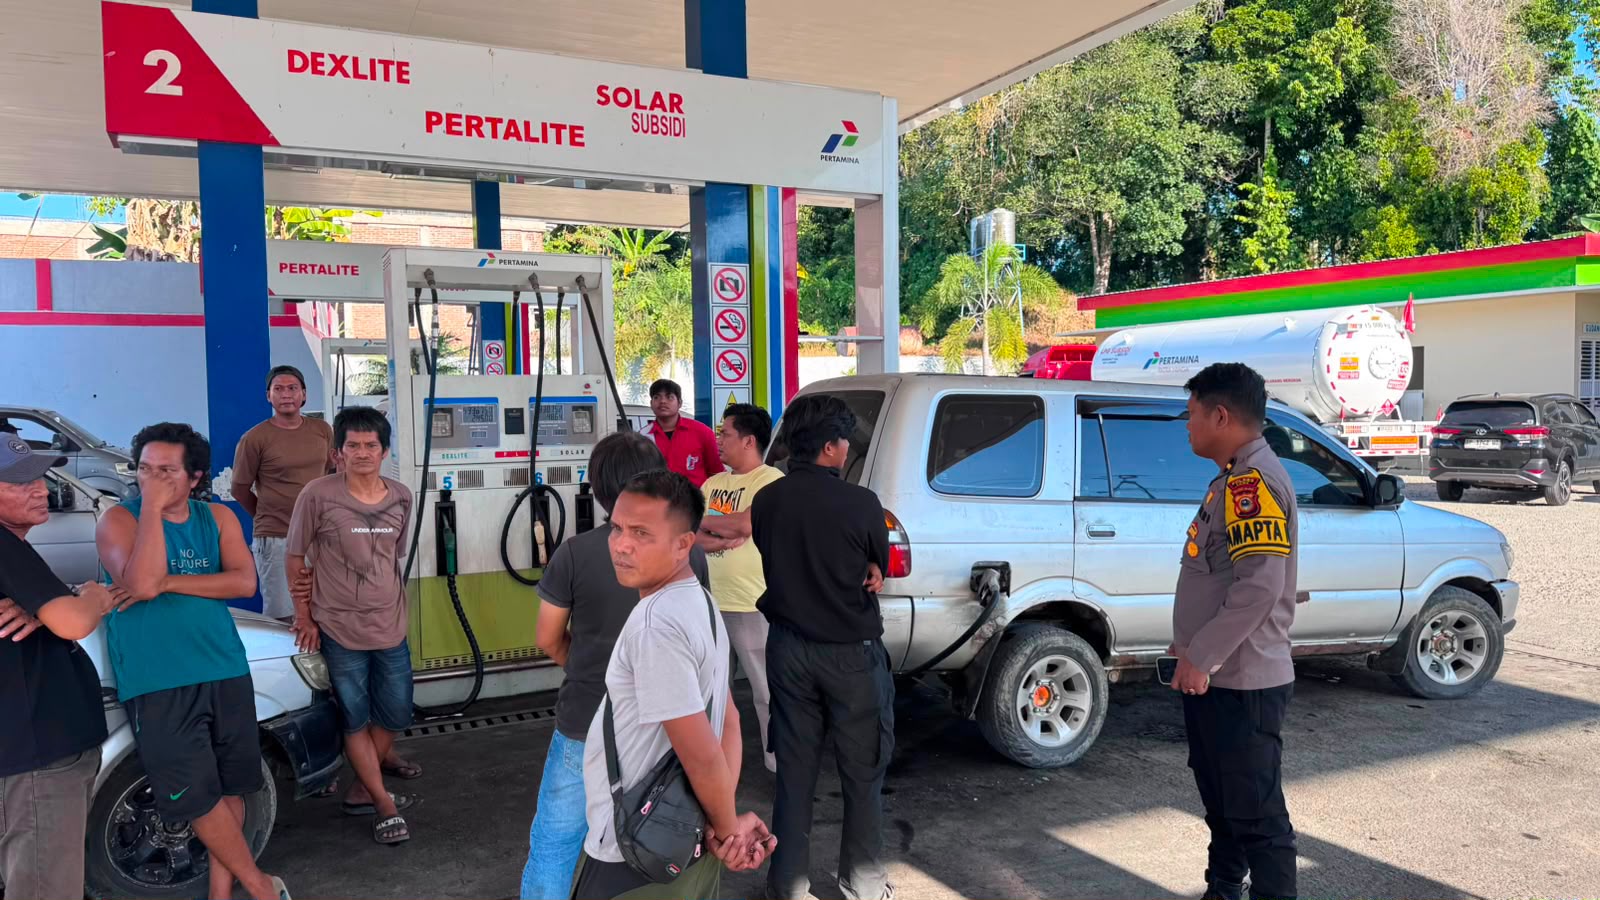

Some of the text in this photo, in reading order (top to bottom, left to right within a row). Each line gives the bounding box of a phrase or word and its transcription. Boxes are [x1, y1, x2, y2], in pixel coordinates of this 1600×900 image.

[142, 49, 184, 97] 2
[286, 49, 411, 85] DEXLITE
[595, 84, 685, 115] SOLAR
[424, 110, 586, 148] PERTALITE
[630, 111, 687, 138] SUBSIDI
[820, 154, 860, 165] PERTAMINA
[278, 261, 361, 277] PERTALITE
[498, 258, 539, 268] PERTAMINA
[1158, 355, 1200, 366] PERTAMINA
[443, 476, 453, 491] 5
[535, 471, 543, 485] 6
[576, 470, 586, 483] 7
[179, 548, 195, 559] NO
[170, 557, 211, 569] FUTURE
